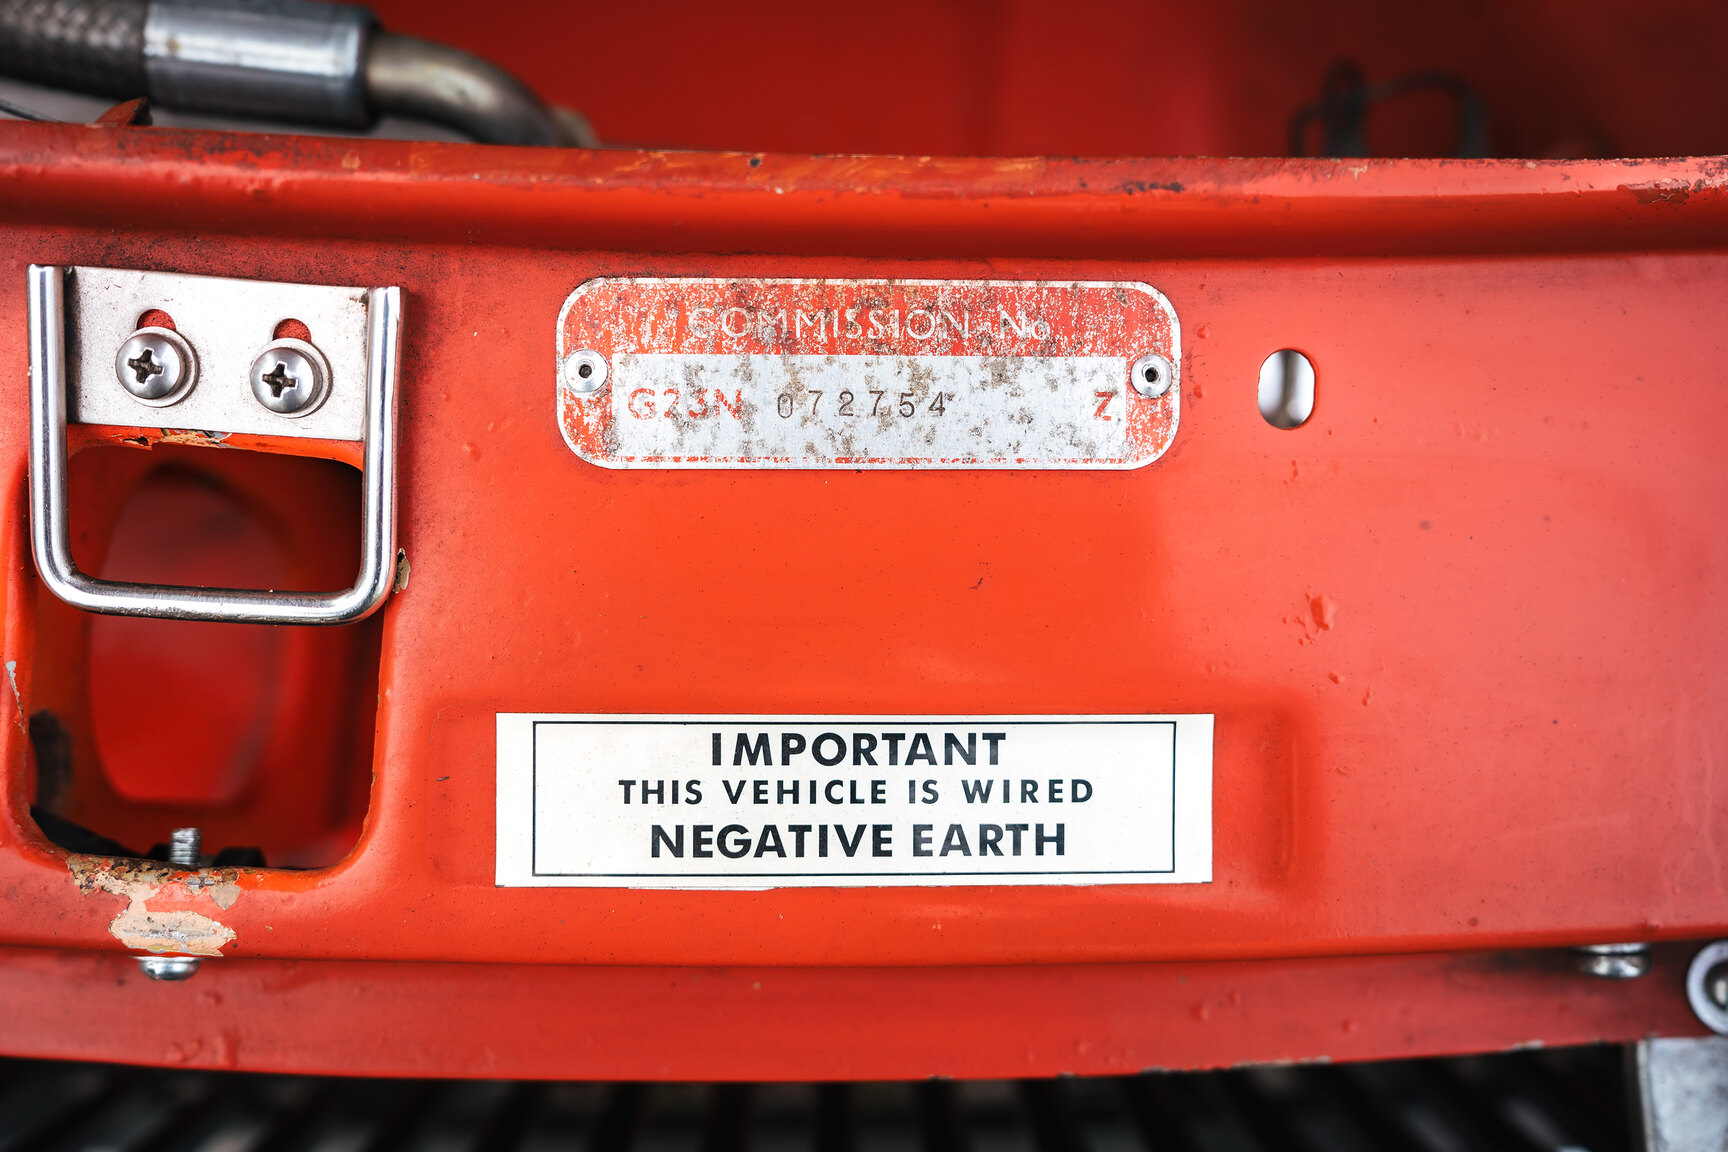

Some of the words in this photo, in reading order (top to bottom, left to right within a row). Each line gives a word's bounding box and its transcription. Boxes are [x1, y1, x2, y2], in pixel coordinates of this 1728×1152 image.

[687, 308, 970, 340] COMMISSION
[627, 387, 743, 420] G23N
[776, 389, 947, 419] 072754
[1093, 390, 1115, 421] Z
[711, 731, 1006, 766] IMPORTANT
[618, 779, 703, 805] THIS
[721, 779, 887, 805] VEHICLE
[908, 779, 940, 805] IS
[961, 778, 1094, 804] WIRED
[650, 824, 893, 859] NEGATIVE
[913, 823, 1066, 857] EARTH
